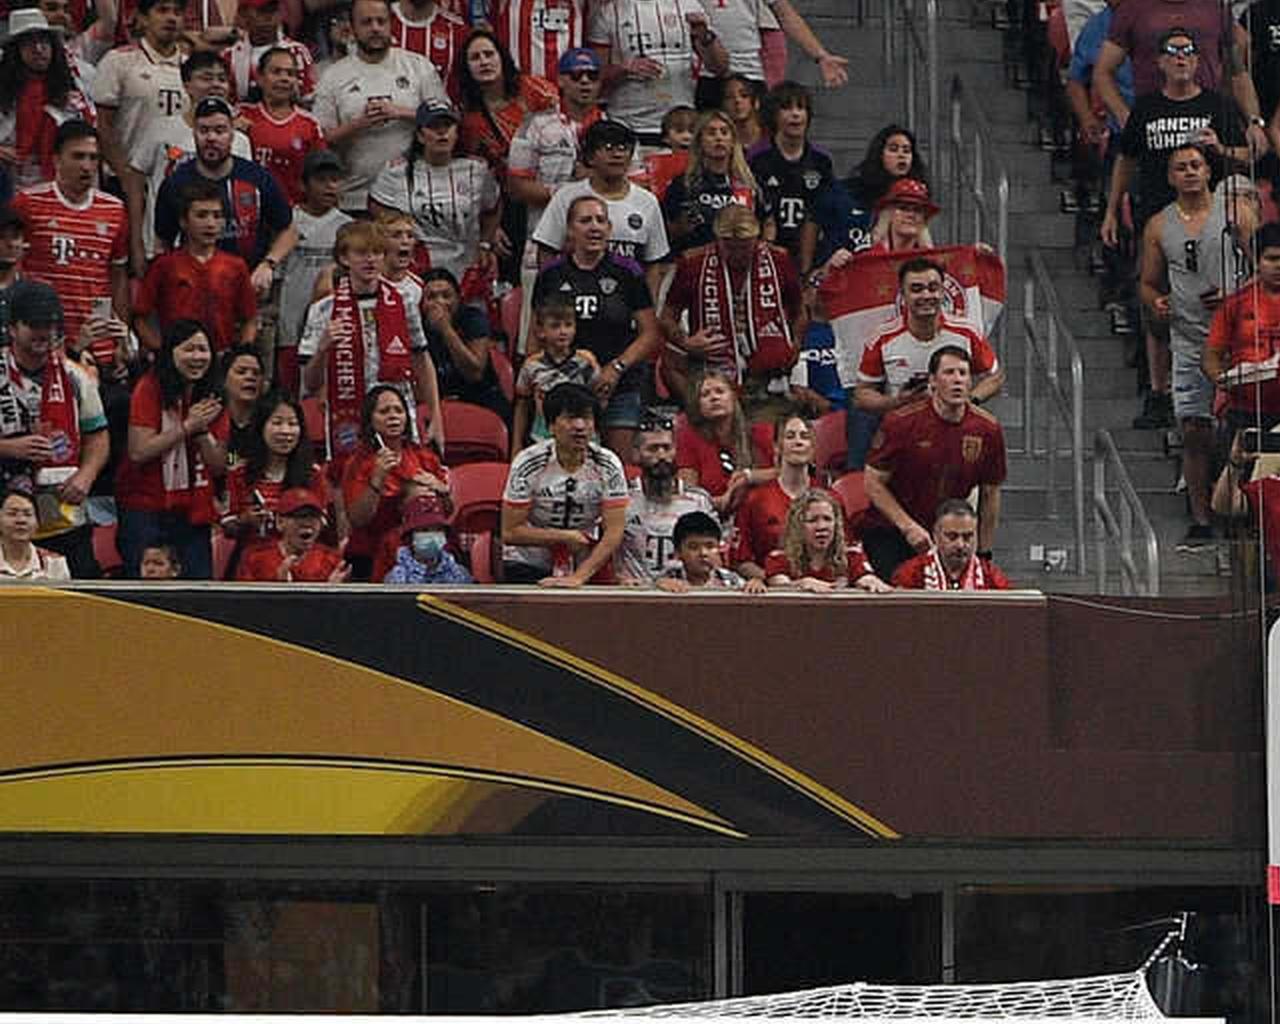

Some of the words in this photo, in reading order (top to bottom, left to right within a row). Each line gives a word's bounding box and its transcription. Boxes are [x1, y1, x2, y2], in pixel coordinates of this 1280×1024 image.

[158, 89, 182, 116] T
[781, 197, 803, 227] T
[52, 236, 77, 266] T
[607, 242, 636, 258] TAR
[576, 295, 598, 319] T
